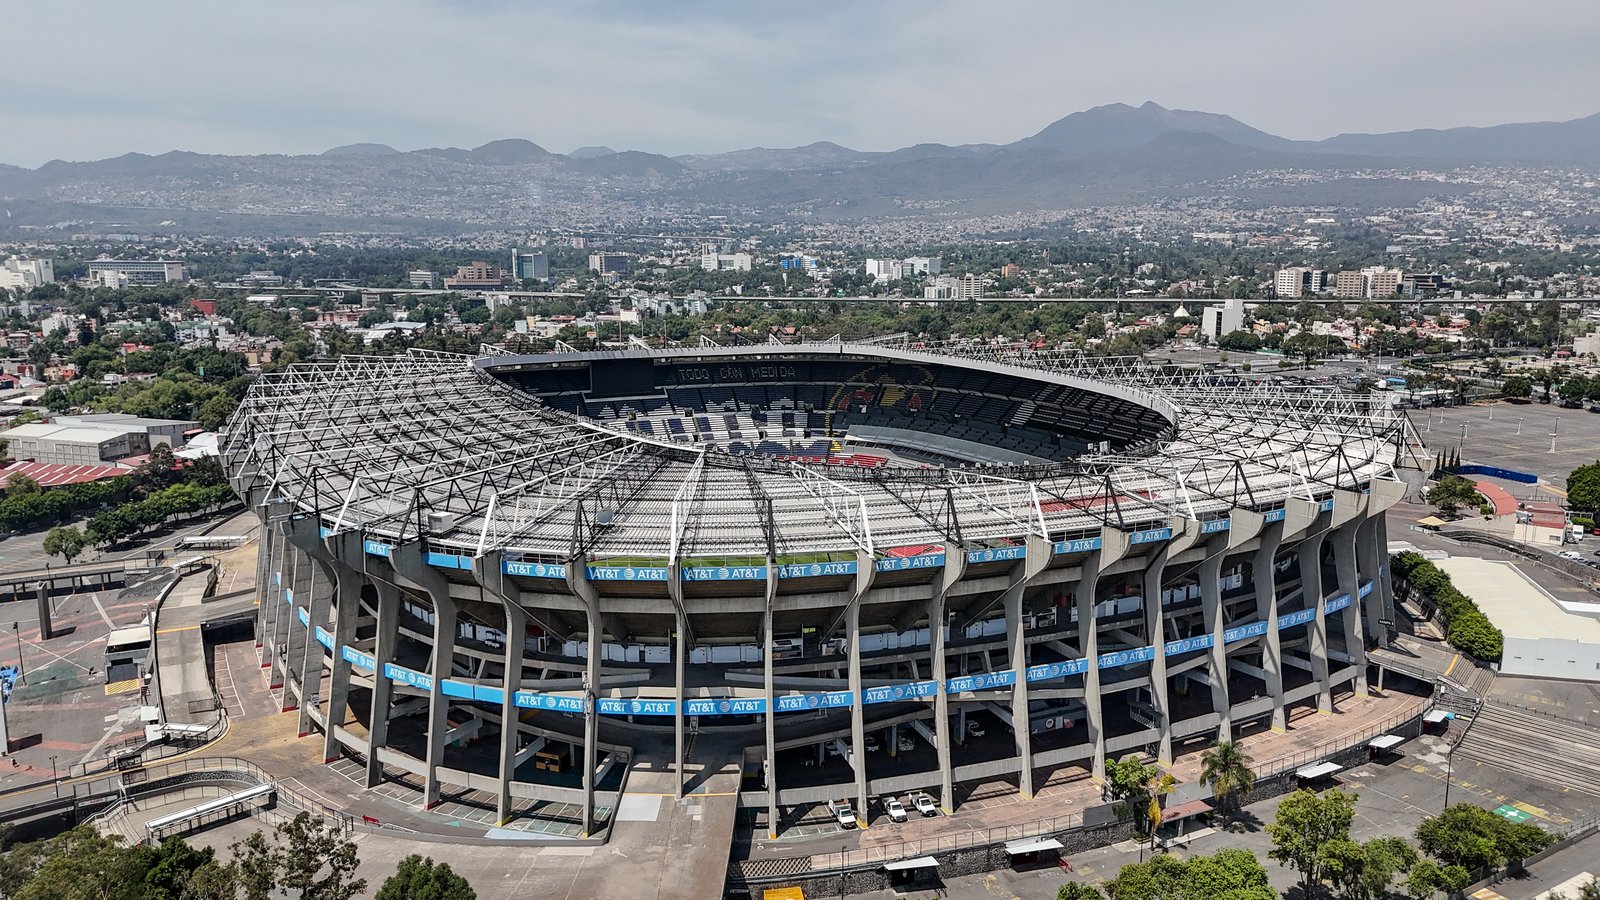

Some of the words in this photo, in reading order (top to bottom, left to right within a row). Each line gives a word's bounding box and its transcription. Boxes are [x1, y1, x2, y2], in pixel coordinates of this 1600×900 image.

[679, 368, 709, 380] TODO
[751, 366, 796, 378] MEDIDA
[1208, 520, 1227, 532] AT&T
[1145, 530, 1165, 541] AT&T
[369, 543, 387, 555] AT&T
[1073, 540, 1095, 551] AT&T
[996, 548, 1019, 559] AT&T
[913, 556, 938, 568] AT&T
[507, 564, 533, 575] AT&T
[548, 566, 566, 577] AT&
[594, 569, 620, 579] AT&T
[637, 569, 664, 579] AT&T
[686, 568, 714, 579] AT&T
[732, 568, 760, 578] AT&T
[780, 566, 807, 578] AT&T
[823, 563, 850, 574] AT&T
[1296, 611, 1312, 623] AT&T
[1247, 624, 1263, 635] AT&T
[1191, 637, 1209, 649] AT&T
[1099, 655, 1118, 666] AT&T
[1129, 649, 1149, 661] AT&T
[389, 668, 407, 680] AT&T
[1027, 667, 1049, 679] AT&T
[1061, 661, 1082, 673] AT&T
[949, 679, 973, 690] AT&T
[986, 674, 1009, 685] AT&T
[865, 690, 891, 701] AT&T
[905, 684, 930, 696] AT&T
[518, 695, 543, 706] AT&T
[558, 698, 583, 709] AT&T
[600, 702, 627, 712] AT&T
[643, 702, 671, 713] AT&T
[688, 702, 716, 713] AT&T
[733, 701, 760, 711] AT&T
[778, 698, 804, 709] AT&T
[821, 694, 847, 706] AT&T
